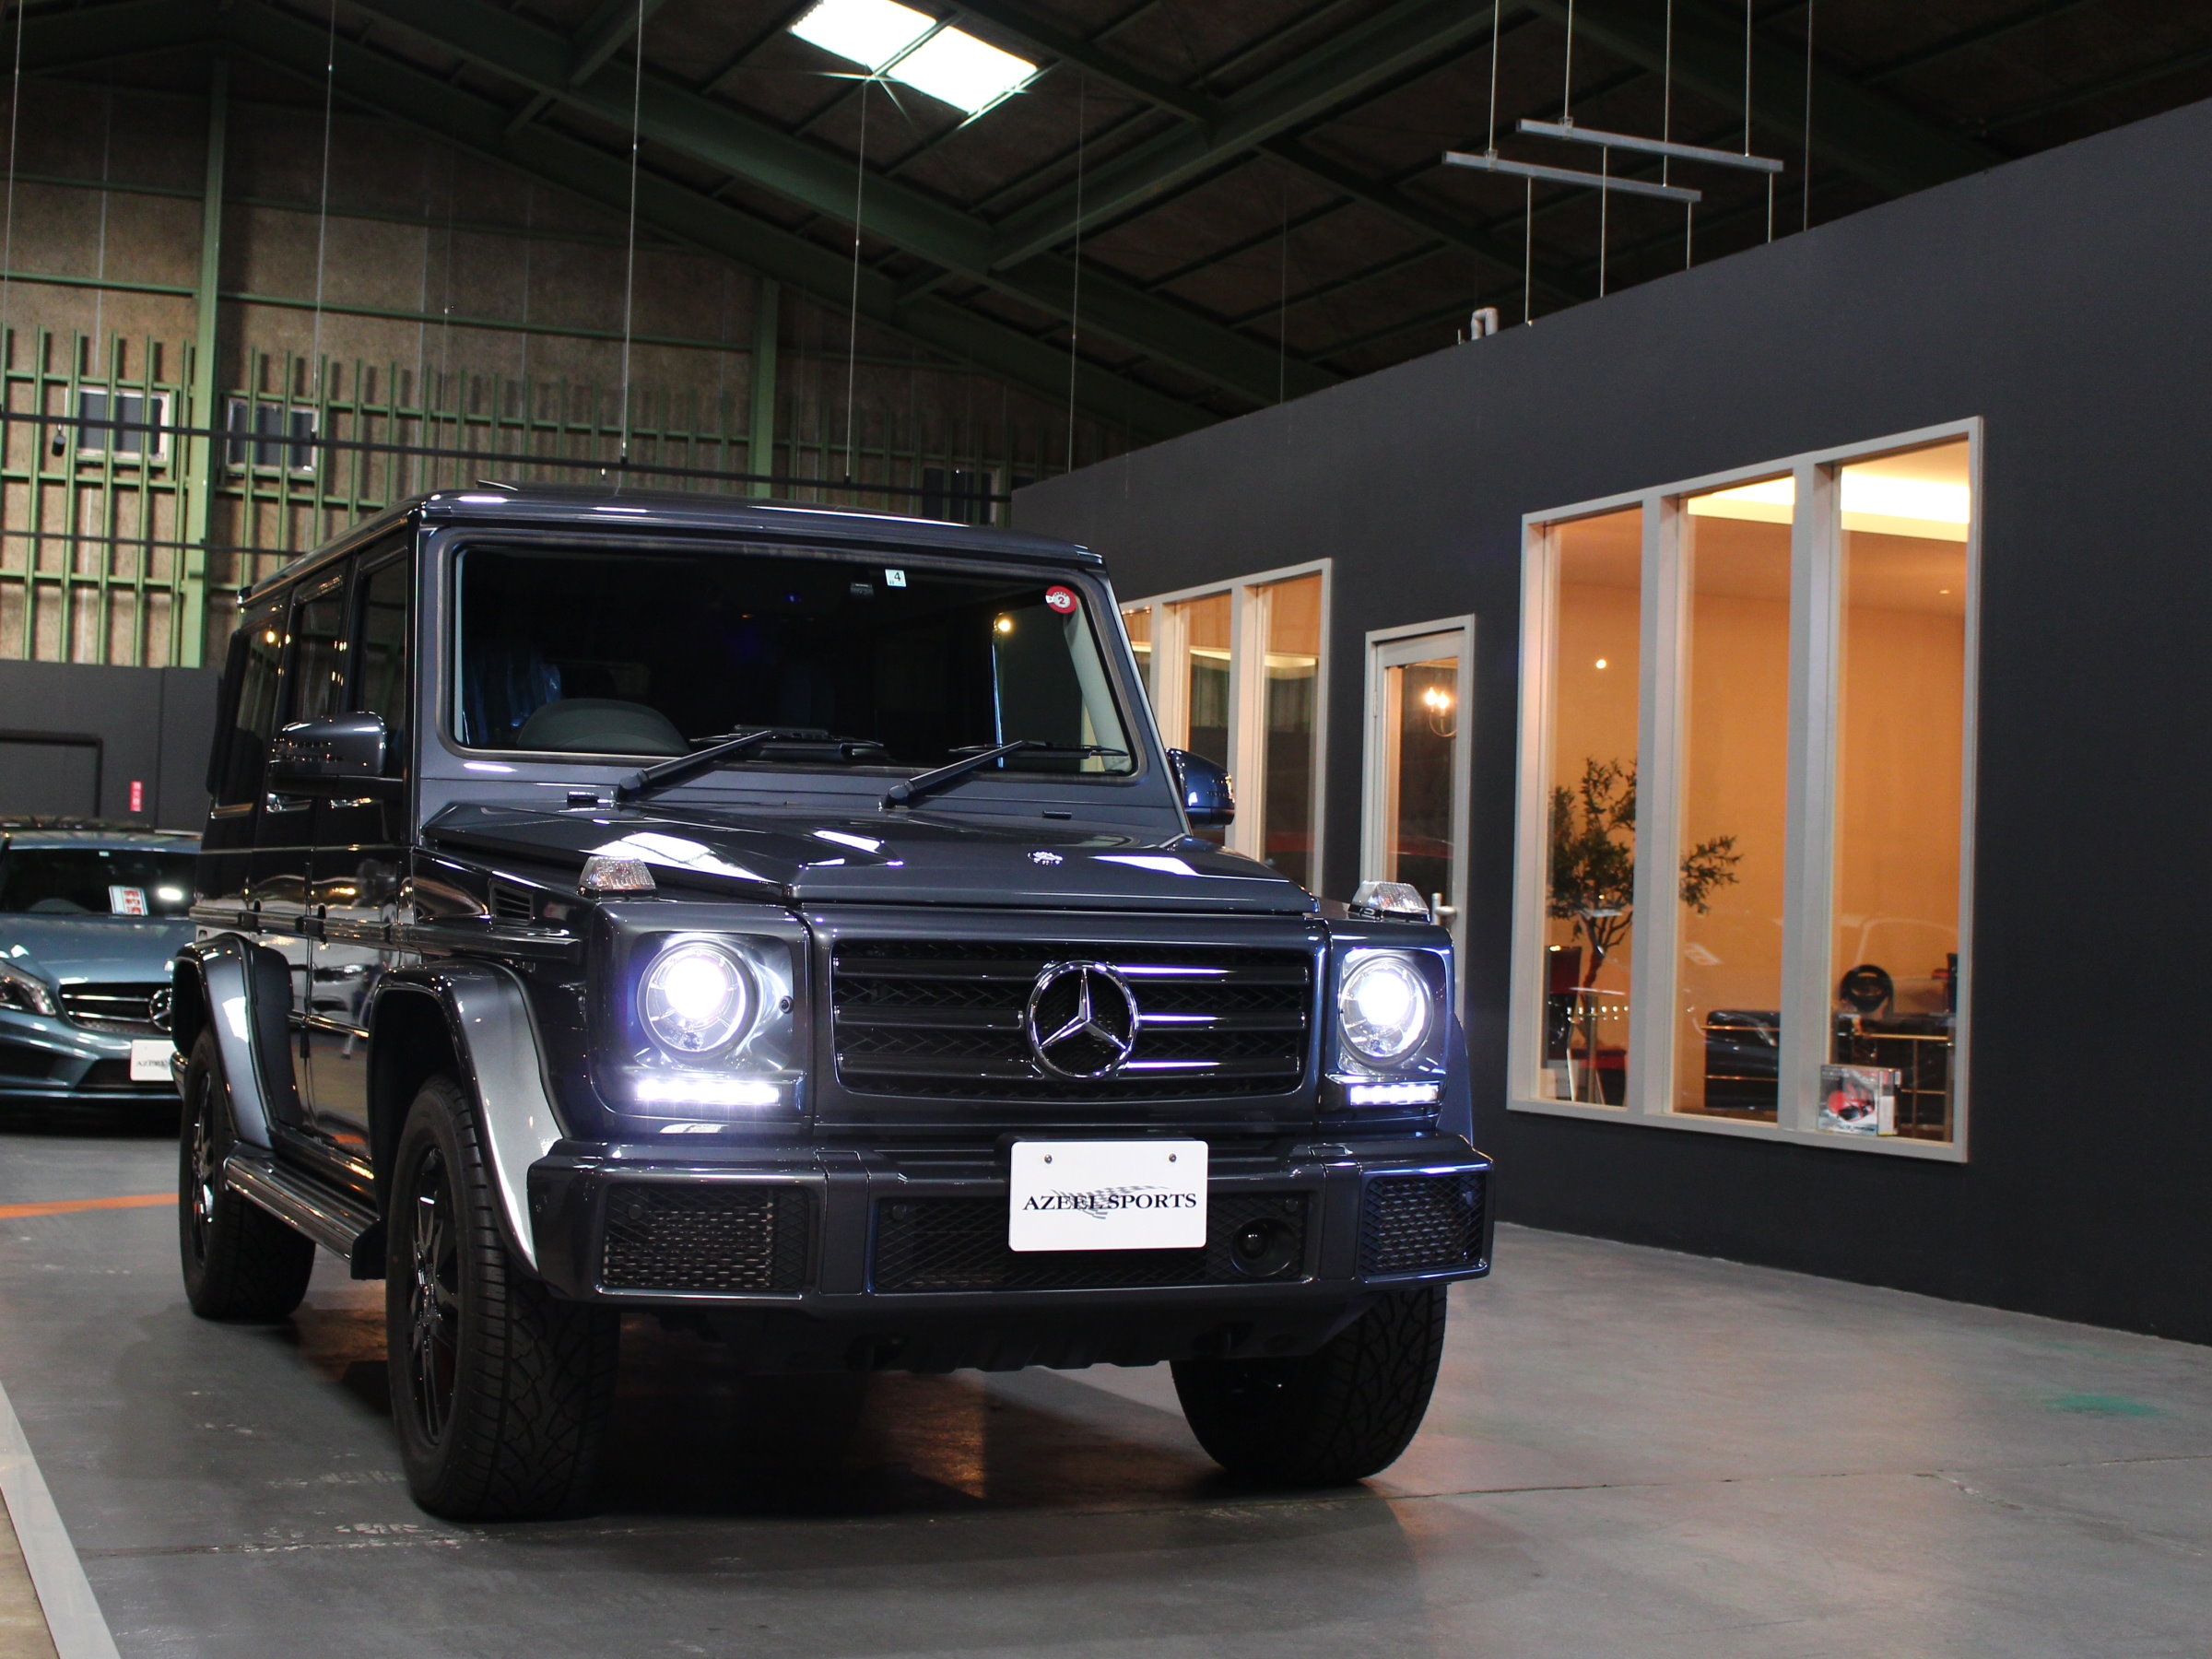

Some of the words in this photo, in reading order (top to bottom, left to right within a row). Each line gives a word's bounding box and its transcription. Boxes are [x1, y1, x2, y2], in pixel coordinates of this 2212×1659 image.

[894, 571, 900, 582] 4
[1058, 596, 1066, 606] 2
[1022, 1195, 1105, 1210] AZEEL
[1106, 1193, 1197, 1209] SPORTS
